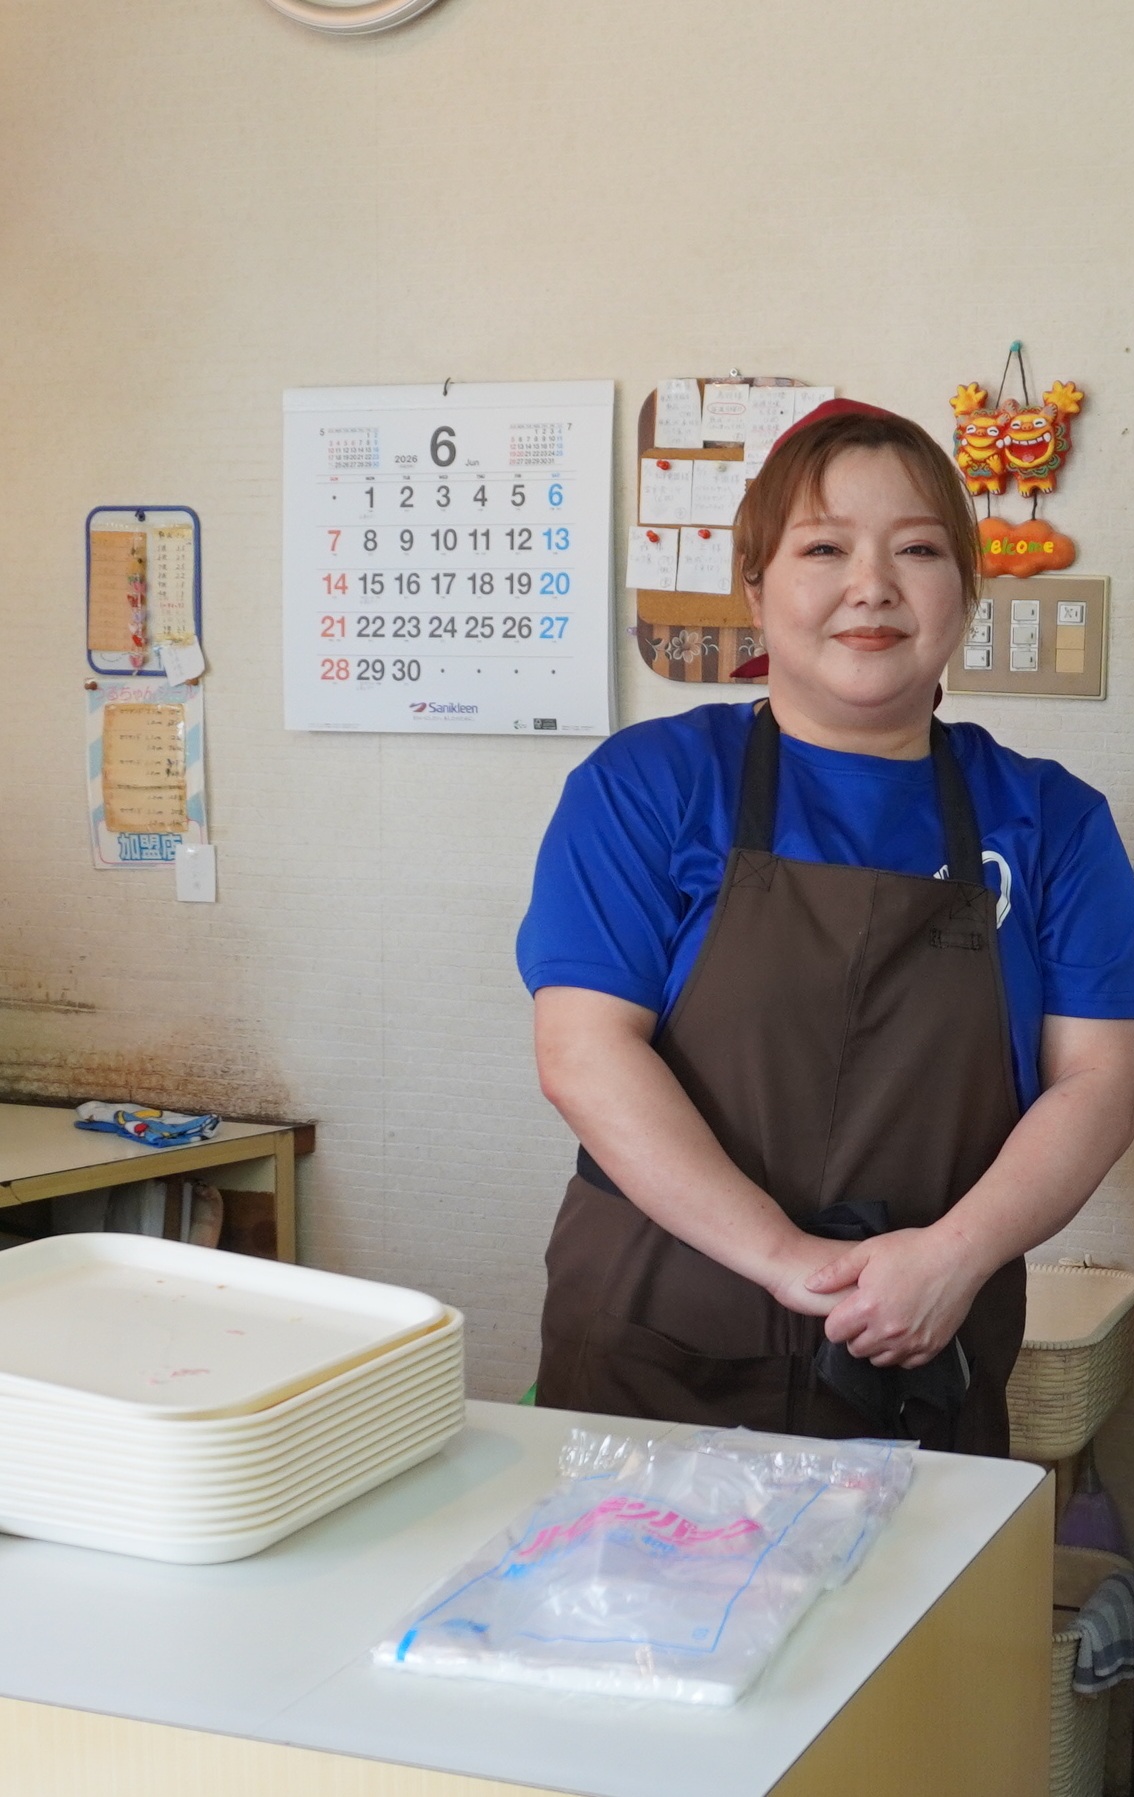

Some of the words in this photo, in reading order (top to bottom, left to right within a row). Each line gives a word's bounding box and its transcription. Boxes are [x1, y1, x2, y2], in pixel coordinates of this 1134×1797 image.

[430, 425, 456, 467] 6
[394, 455, 418, 464] 2026
[465, 458, 480, 467] Jun
[365, 487, 373, 508] 1
[400, 486, 413, 508] 2
[437, 485, 450, 507] 3
[473, 485, 487, 507] 4
[511, 485, 525, 507] 5
[548, 484, 563, 509] 6
[328, 530, 341, 551] 7
[364, 530, 377, 551] 8
[400, 529, 413, 551] 9
[431, 529, 457, 551] 10
[469, 529, 489, 550] 11
[506, 529, 532, 550] 12
[543, 529, 569, 550] 13
[323, 573, 348, 594] 14
[359, 573, 384, 595] 15
[395, 573, 420, 595] 16
[431, 573, 456, 594] 17
[467, 573, 494, 595] 18
[505, 572, 531, 595] 19
[540, 572, 570, 595] 20
[321, 616, 345, 637] 21
[357, 616, 385, 637] 22
[393, 616, 421, 638] 23
[429, 616, 457, 638] 24
[465, 616, 494, 638] 25
[502, 616, 532, 638] 26
[540, 616, 569, 639] 27
[321, 658, 350, 680] 28
[357, 659, 385, 681] 29
[392, 659, 421, 681] 30
[428, 702, 479, 714] Sanikleen
[118, 832, 183, 861] 加盟店
